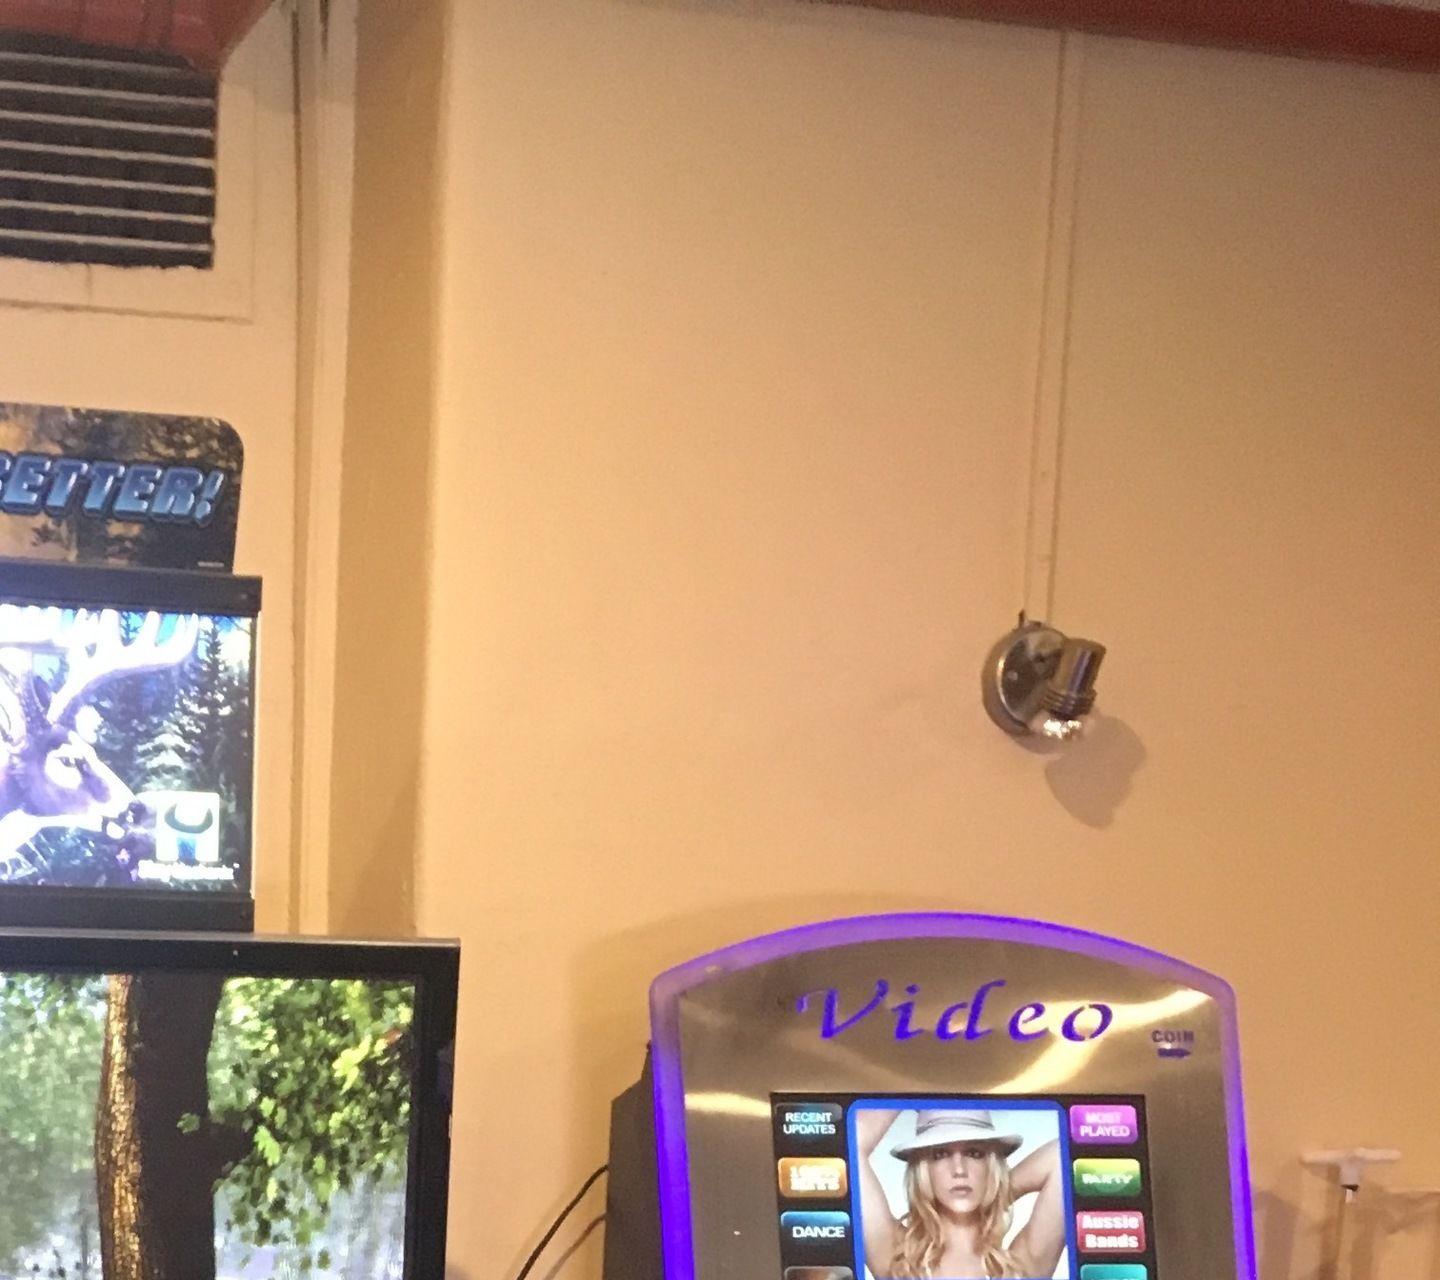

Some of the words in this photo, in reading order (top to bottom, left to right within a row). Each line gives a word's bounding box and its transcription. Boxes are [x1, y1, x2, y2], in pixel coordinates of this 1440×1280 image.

[796, 979, 1114, 1042] Video
[785, 1112, 832, 1122] RECENT
[783, 1124, 836, 1134] UPDATES
[1080, 1126, 1130, 1137] PLAYED
[1082, 1215, 1139, 1229] Aussie
[792, 1226, 845, 1238] DANCE
[1085, 1234, 1139, 1248] Bands
